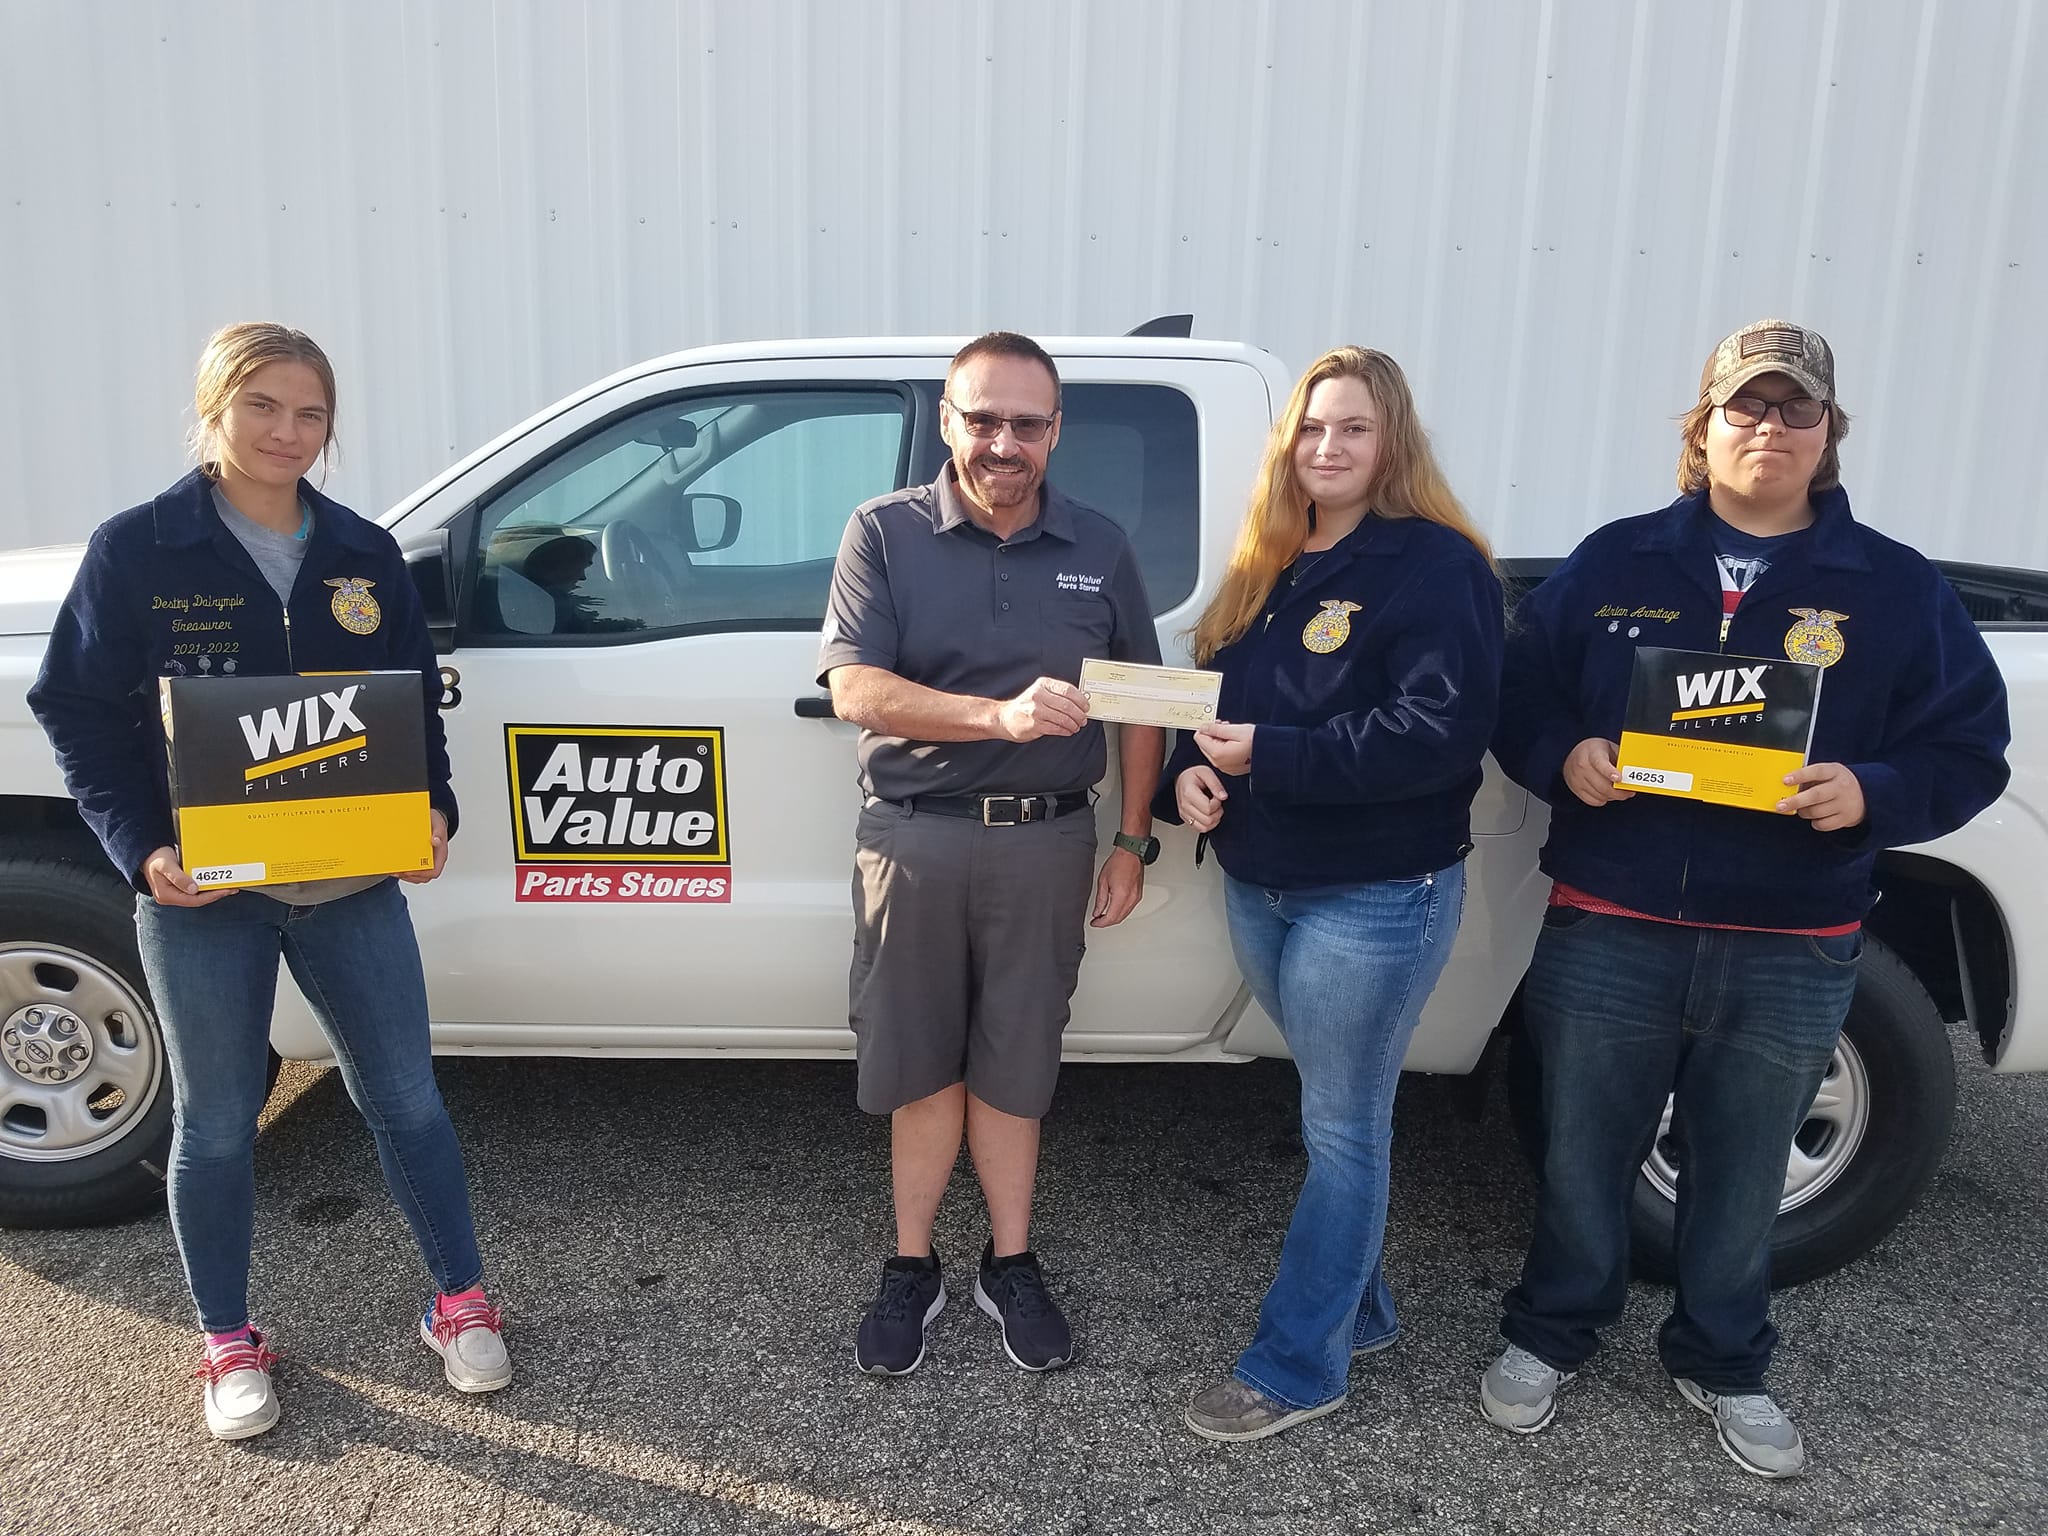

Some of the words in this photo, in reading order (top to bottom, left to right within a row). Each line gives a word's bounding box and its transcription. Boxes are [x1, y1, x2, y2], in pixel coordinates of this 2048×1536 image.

[1056, 572, 1078, 583] Auto
[1078, 574, 1102, 585] Value
[1058, 582, 1078, 590] Parts
[1078, 583, 1100, 592] Stores
[152, 596, 189, 613] Destiny
[1594, 604, 1629, 617] Adrian
[1630, 606, 1680, 623] Armitage
[172, 619, 232, 632] Treasurer
[173, 642, 239, 655] 2021-2022
[1676, 665, 1768, 708] WIX
[238, 685, 367, 761] WIX
[1669, 713, 1764, 731] FILTERS
[245, 750, 368, 795] FILTERS
[531, 743, 704, 794] Auto
[1628, 771, 1665, 784] 46253
[248, 812, 279, 820] QUALITY
[524, 796, 715, 846] Value
[196, 869, 233, 881] 46272
[521, 871, 612, 897] Parts
[618, 871, 727, 898] Stores
